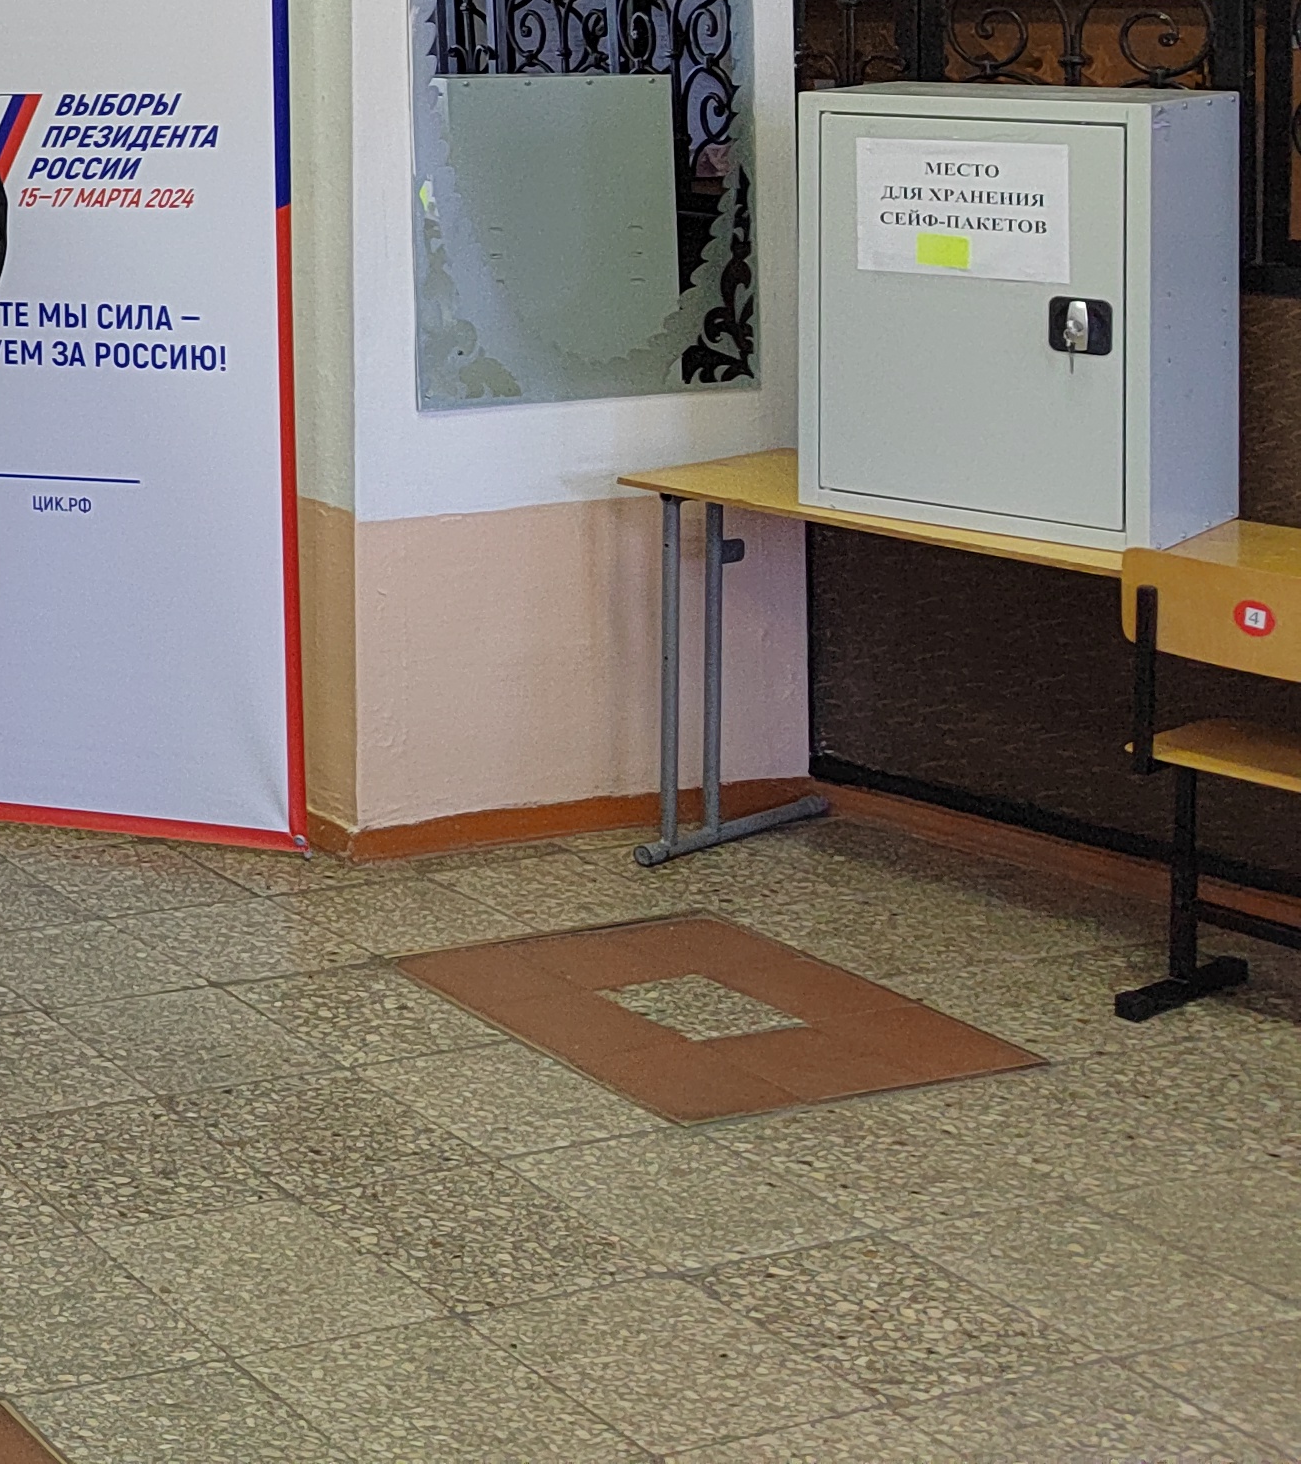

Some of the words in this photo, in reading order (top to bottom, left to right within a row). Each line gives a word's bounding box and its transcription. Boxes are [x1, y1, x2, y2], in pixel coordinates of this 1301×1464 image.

[55, 93, 182, 116] ВЫБОРЫ
[41, 125, 219, 151] ПРЕЗИДЕНТА
[28, 157, 142, 179] РОССИИ
[924, 161, 1000, 178] МЕСТО
[74, 188, 141, 208] МАРТА
[145, 188, 194, 208] 2024
[881, 185, 922, 201] ДЛЯ
[929, 188, 1045, 207] ХРАНЕНИЯ
[880, 209, 1047, 234] СЕЙФ-ПАКЕТОВ
[39, 302, 87, 328] МЫ
[97, 303, 173, 330] СИЛА
[52, 341, 86, 367] ЗА
[95, 342, 226, 371] РОССИЮ!
[32, 495, 92, 513] ЦИК.РФ
[1248, 612, 1259, 625] 4
